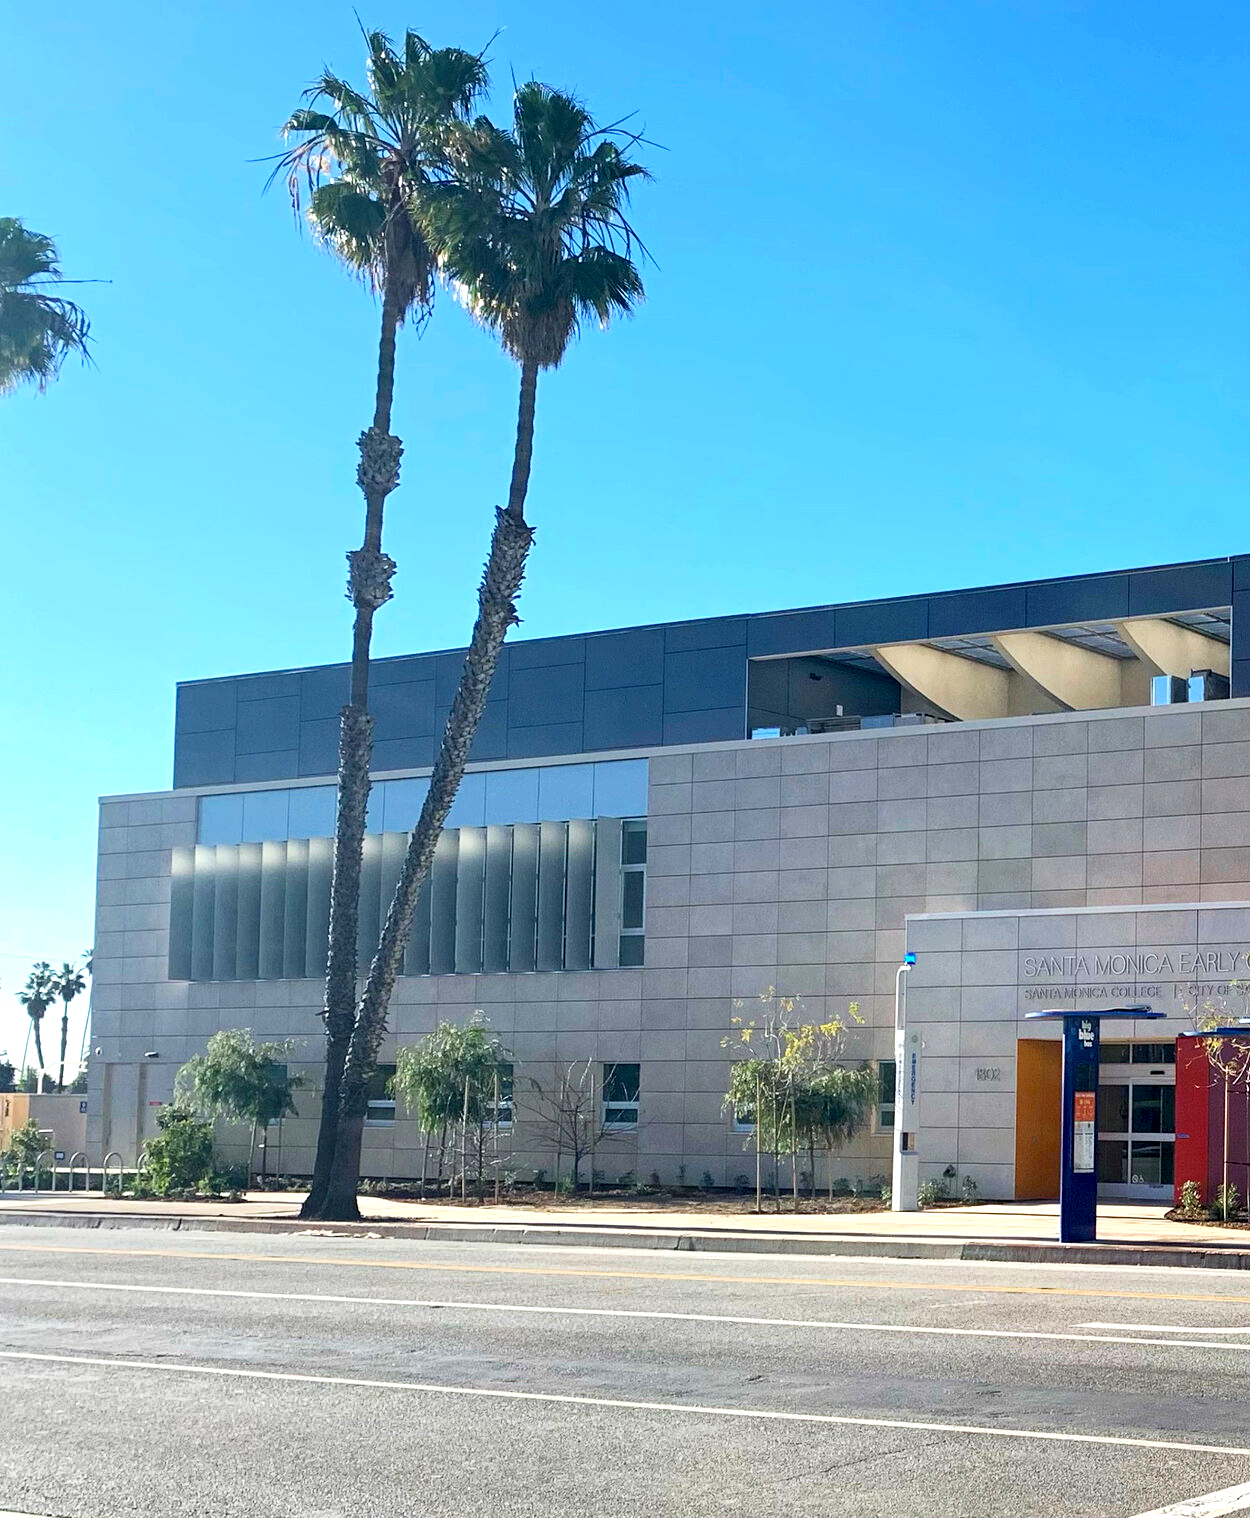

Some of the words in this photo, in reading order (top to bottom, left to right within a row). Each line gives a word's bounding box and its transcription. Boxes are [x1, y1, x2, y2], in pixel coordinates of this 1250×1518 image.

[1024, 955, 1090, 977] SANTA
[1094, 953, 1174, 976] MONICA
[1179, 951, 1240, 973] EARLY
[1025, 987, 1061, 999] SANTA
[1064, 986, 1107, 999] MONICA
[1110, 984, 1162, 998] COLLEGE
[1189, 983, 1214, 997] CITY
[1217, 983, 1233, 996] OF
[1079, 1028, 1095, 1040] blue
